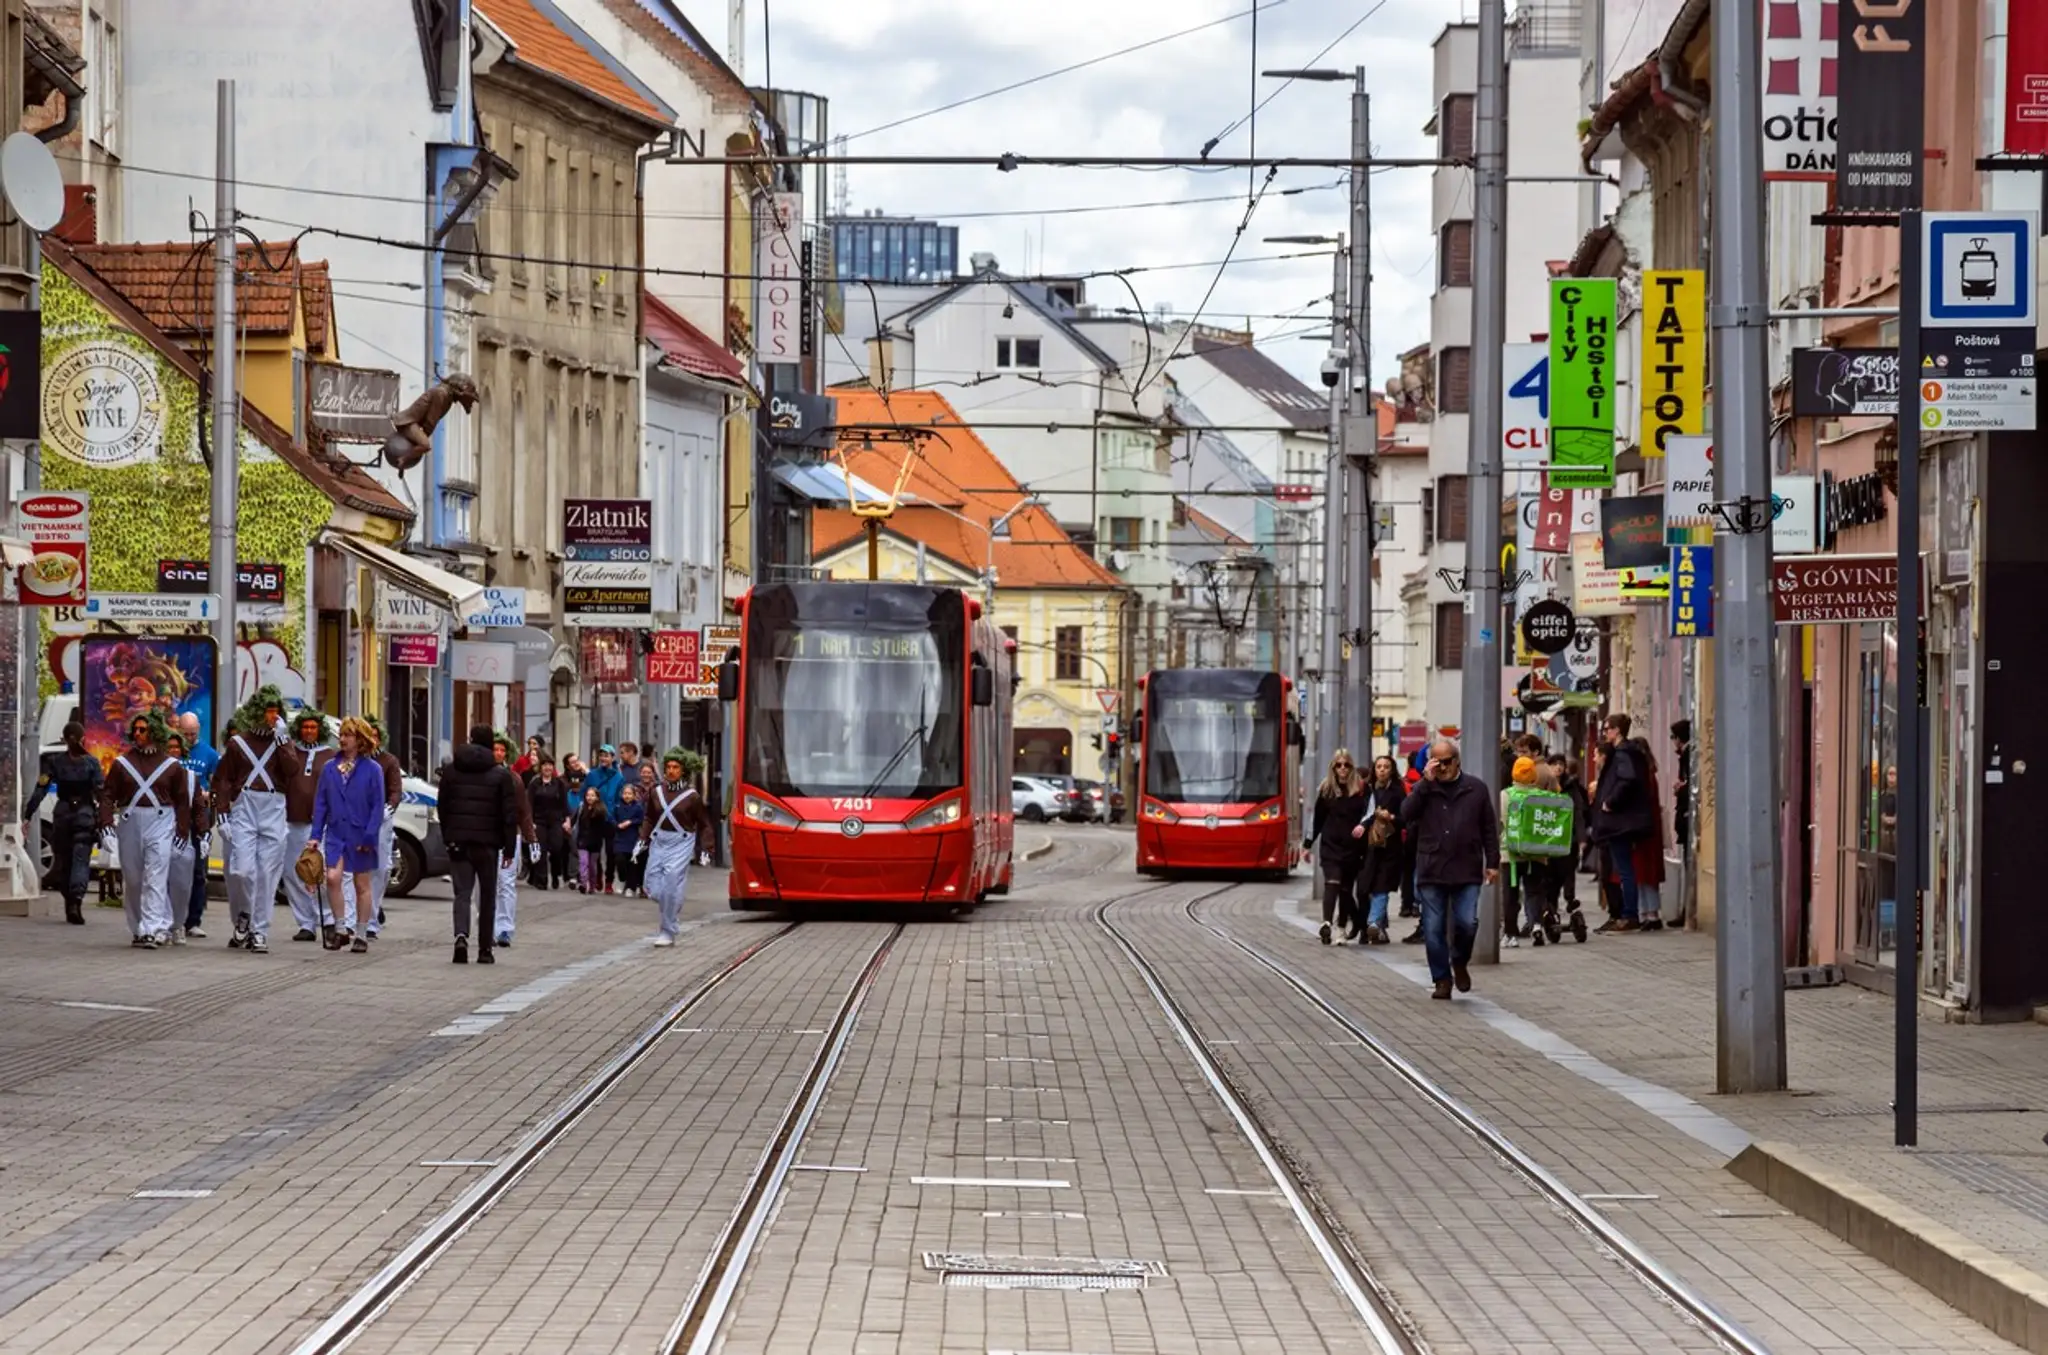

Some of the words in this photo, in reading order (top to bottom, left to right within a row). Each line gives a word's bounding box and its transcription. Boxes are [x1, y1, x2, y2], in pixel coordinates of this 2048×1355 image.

[1848, 172, 1860, 186] OD
[1560, 286, 1582, 363] City
[1955, 334, 2000, 346] Poštová
[1586, 316, 1606, 419] Hostel
[1928, 386, 1935, 399] 1
[1946, 382, 1975, 391] Hlavná
[1947, 393, 1967, 401] Main
[1969, 392, 1998, 402] Station
[75, 408, 128, 428] WINE
[1927, 412, 1936, 425] 9
[1946, 419, 2005, 427] Astronomická
[1673, 480, 1714, 493] PAPIE
[21, 523, 83, 531] VIETNAMSKÉ
[610, 548, 649, 560] SÍDLO
[108, 598, 149, 606] NÁKUPNÉ
[388, 599, 430, 616] WINE
[110, 608, 153, 616] SHOPPING
[1531, 614, 1568, 625] eiffel
[1531, 628, 1568, 639] optic
[650, 661, 695, 678] PIZZA
[832, 798, 872, 811] 7401
[1534, 808, 1557, 822] Bolt
[1533, 823, 1563, 837] Food
